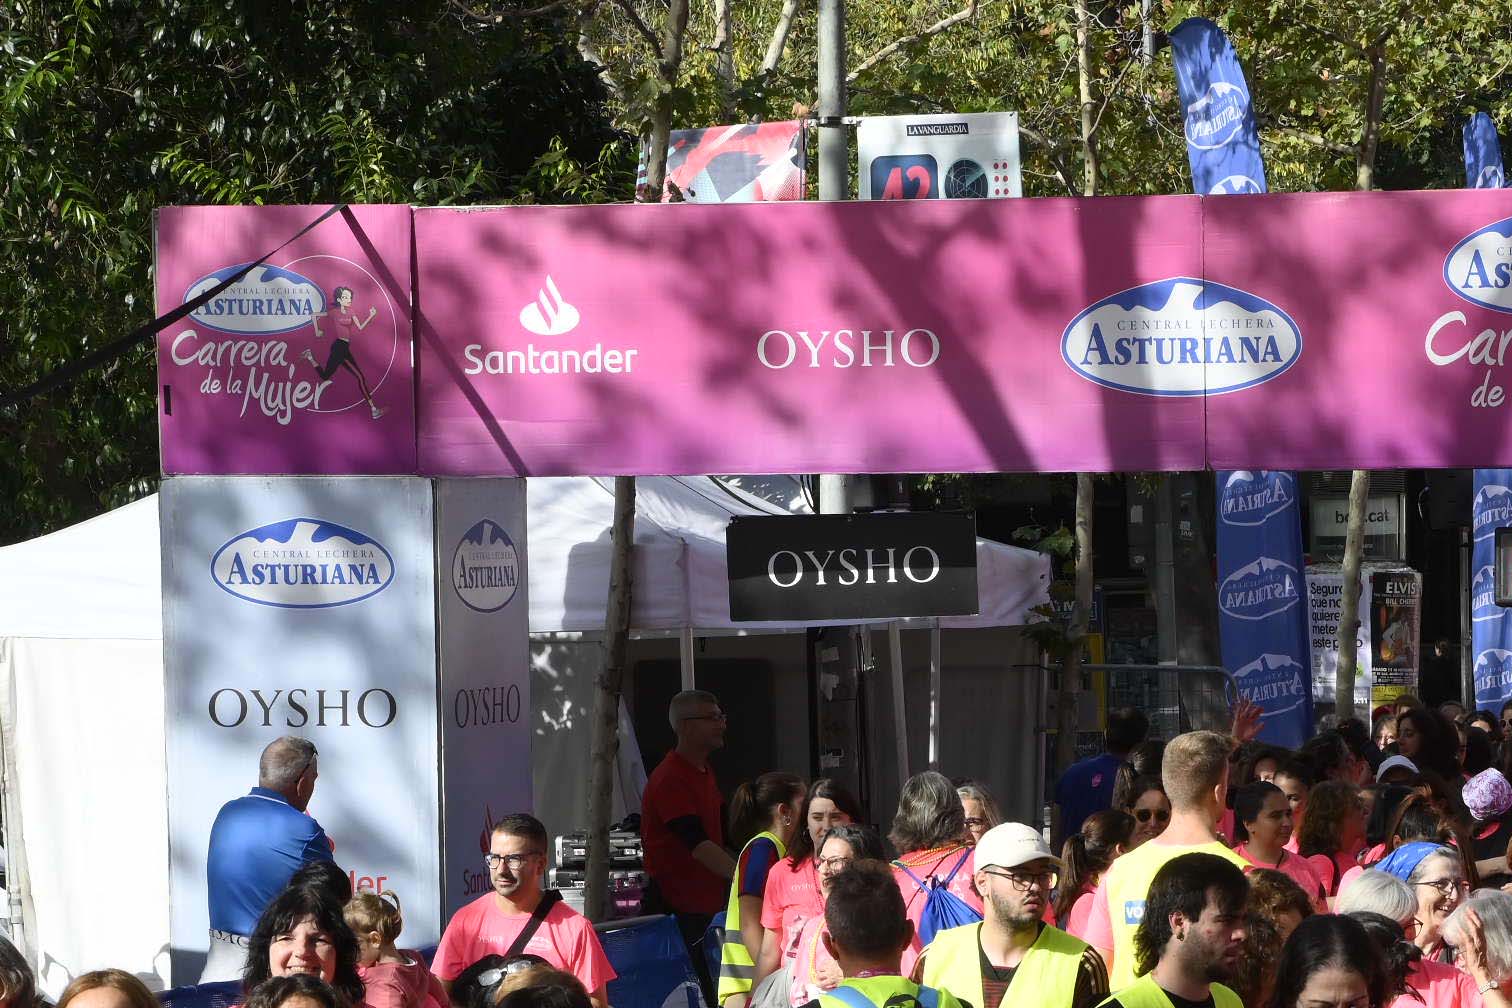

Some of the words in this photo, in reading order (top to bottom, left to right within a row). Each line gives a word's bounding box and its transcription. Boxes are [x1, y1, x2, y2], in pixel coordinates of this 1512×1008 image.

[907, 124, 919, 136] LA
[919, 122, 968, 135] VANGUARDIA
[193, 289, 313, 316] ASTURIANA
[223, 287, 260, 295] ENTRAL
[1116, 319, 1192, 331] CENTRAL
[1200, 318, 1275, 330] LECHERA
[171, 329, 288, 367] Carrera
[464, 343, 639, 375] Santander
[756, 328, 941, 370] OYSHO
[1080, 323, 1283, 366] ASTURIANA
[200, 368, 222, 394] de
[226, 366, 243, 394] la
[240, 363, 334, 426] Mujer
[1471, 369, 1504, 408] de
[225, 552, 382, 586] ASTURIANA
[253, 550, 311, 559] CENTRAL
[316, 550, 375, 559] LECHERA
[457, 554, 515, 590] ASTURIANA
[766, 546, 941, 588] OYSHO
[1385, 582, 1416, 595] ELVIS
[1312, 611, 1344, 622] quiere
[208, 688, 397, 729] OYSHO
[454, 683, 521, 729] OYSHO
